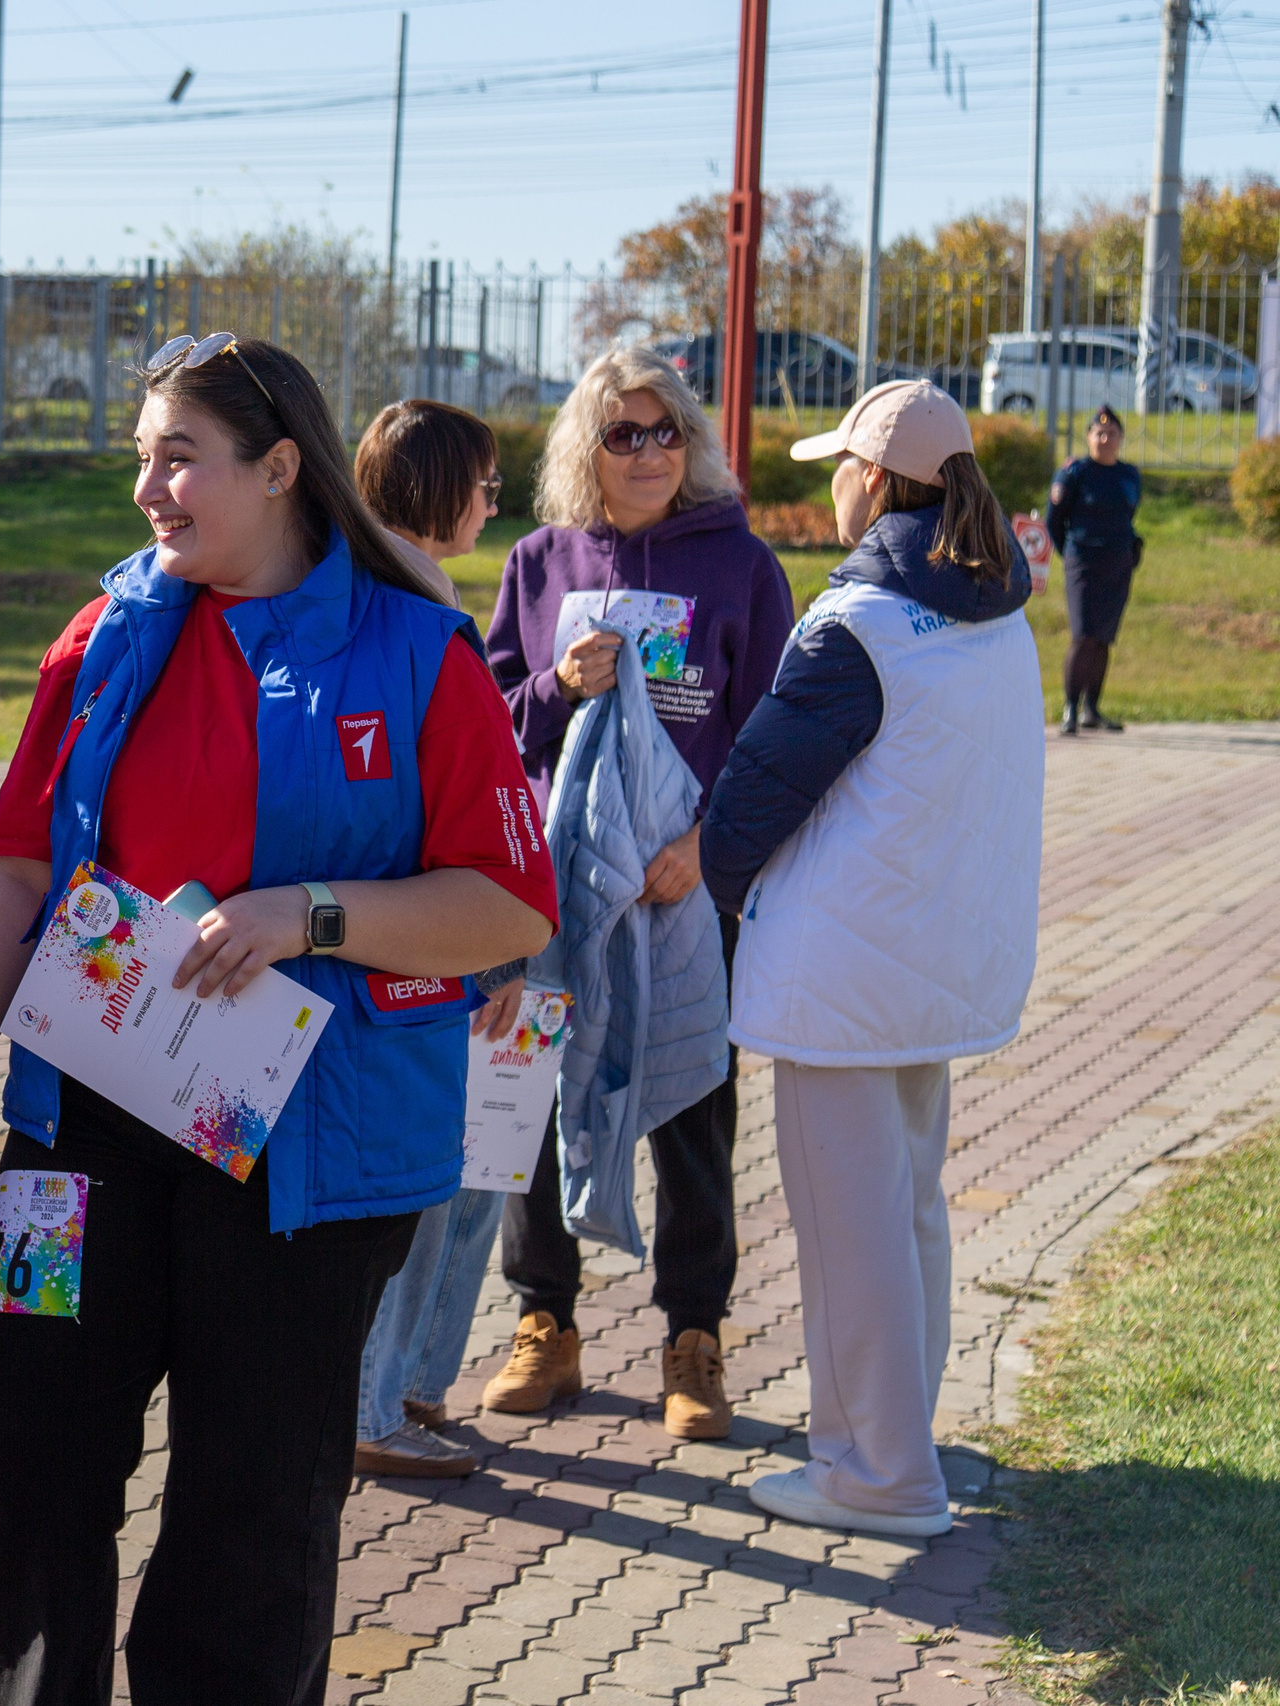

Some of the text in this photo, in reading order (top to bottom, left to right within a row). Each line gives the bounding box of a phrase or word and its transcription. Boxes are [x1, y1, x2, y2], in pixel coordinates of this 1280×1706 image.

[648, 691, 706, 707] porting Goods
[677, 685, 714, 699] Research
[342, 718, 379, 729] Первые
[502, 787, 518, 837] Российское
[517, 788, 540, 853] Первые
[102, 911, 112, 924] 2024
[101, 957, 148, 1034] ДИПЛОМ
[387, 978, 446, 1000] ПЕРВЫХ
[133, 986, 158, 1028] НАГРАЖДАЕТСЯ
[168, 1033, 180, 1049] участие
[490, 1050, 534, 1068] ДИПЛОМ
[29, 1204, 67, 1213] ДЕНЬ ХОДЬБЫ
[40, 1212, 53, 1220] 2024
